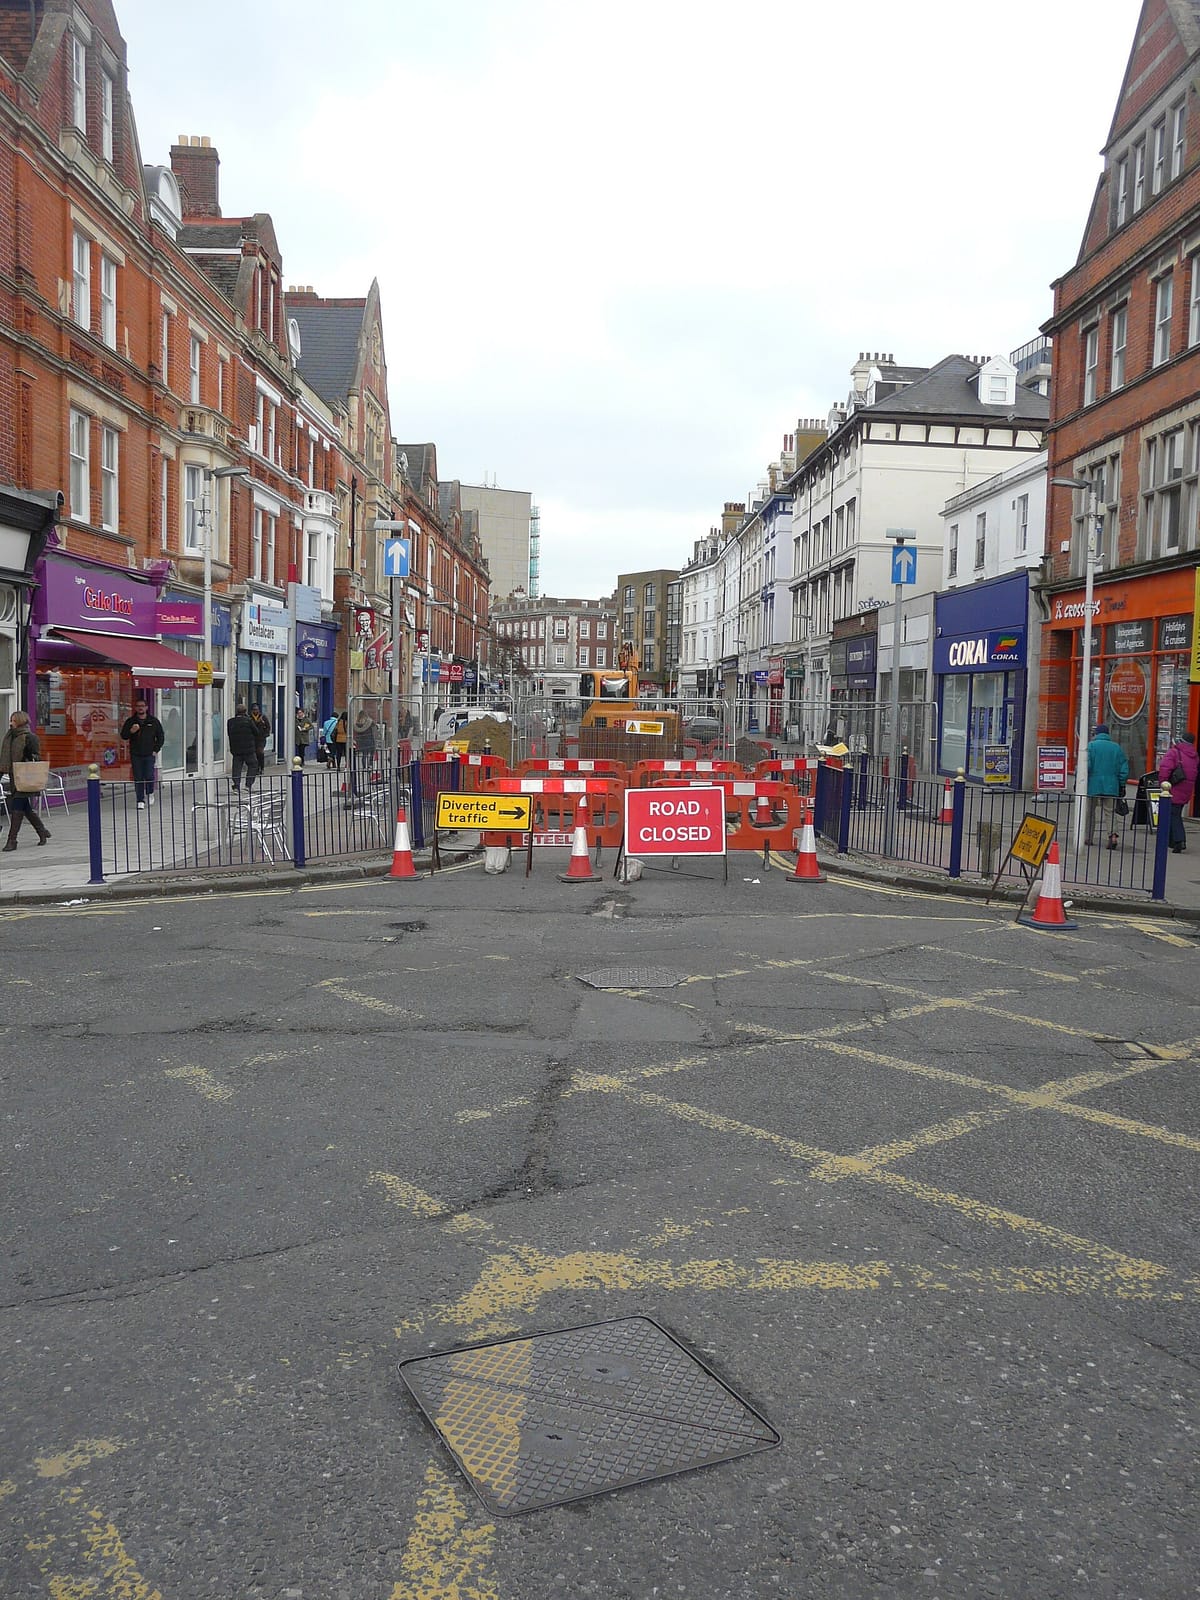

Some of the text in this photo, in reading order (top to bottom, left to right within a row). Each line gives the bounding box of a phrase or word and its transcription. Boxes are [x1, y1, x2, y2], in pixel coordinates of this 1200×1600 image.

[84, 586, 133, 615] Cake Box
[1165, 622, 1186, 633] Holidays
[1169, 637, 1187, 645] cruises
[442, 800, 497, 812] Diverted
[649, 801, 701, 816] ROAD
[448, 812, 489, 824] traffic
[639, 826, 712, 842] CLOSED
